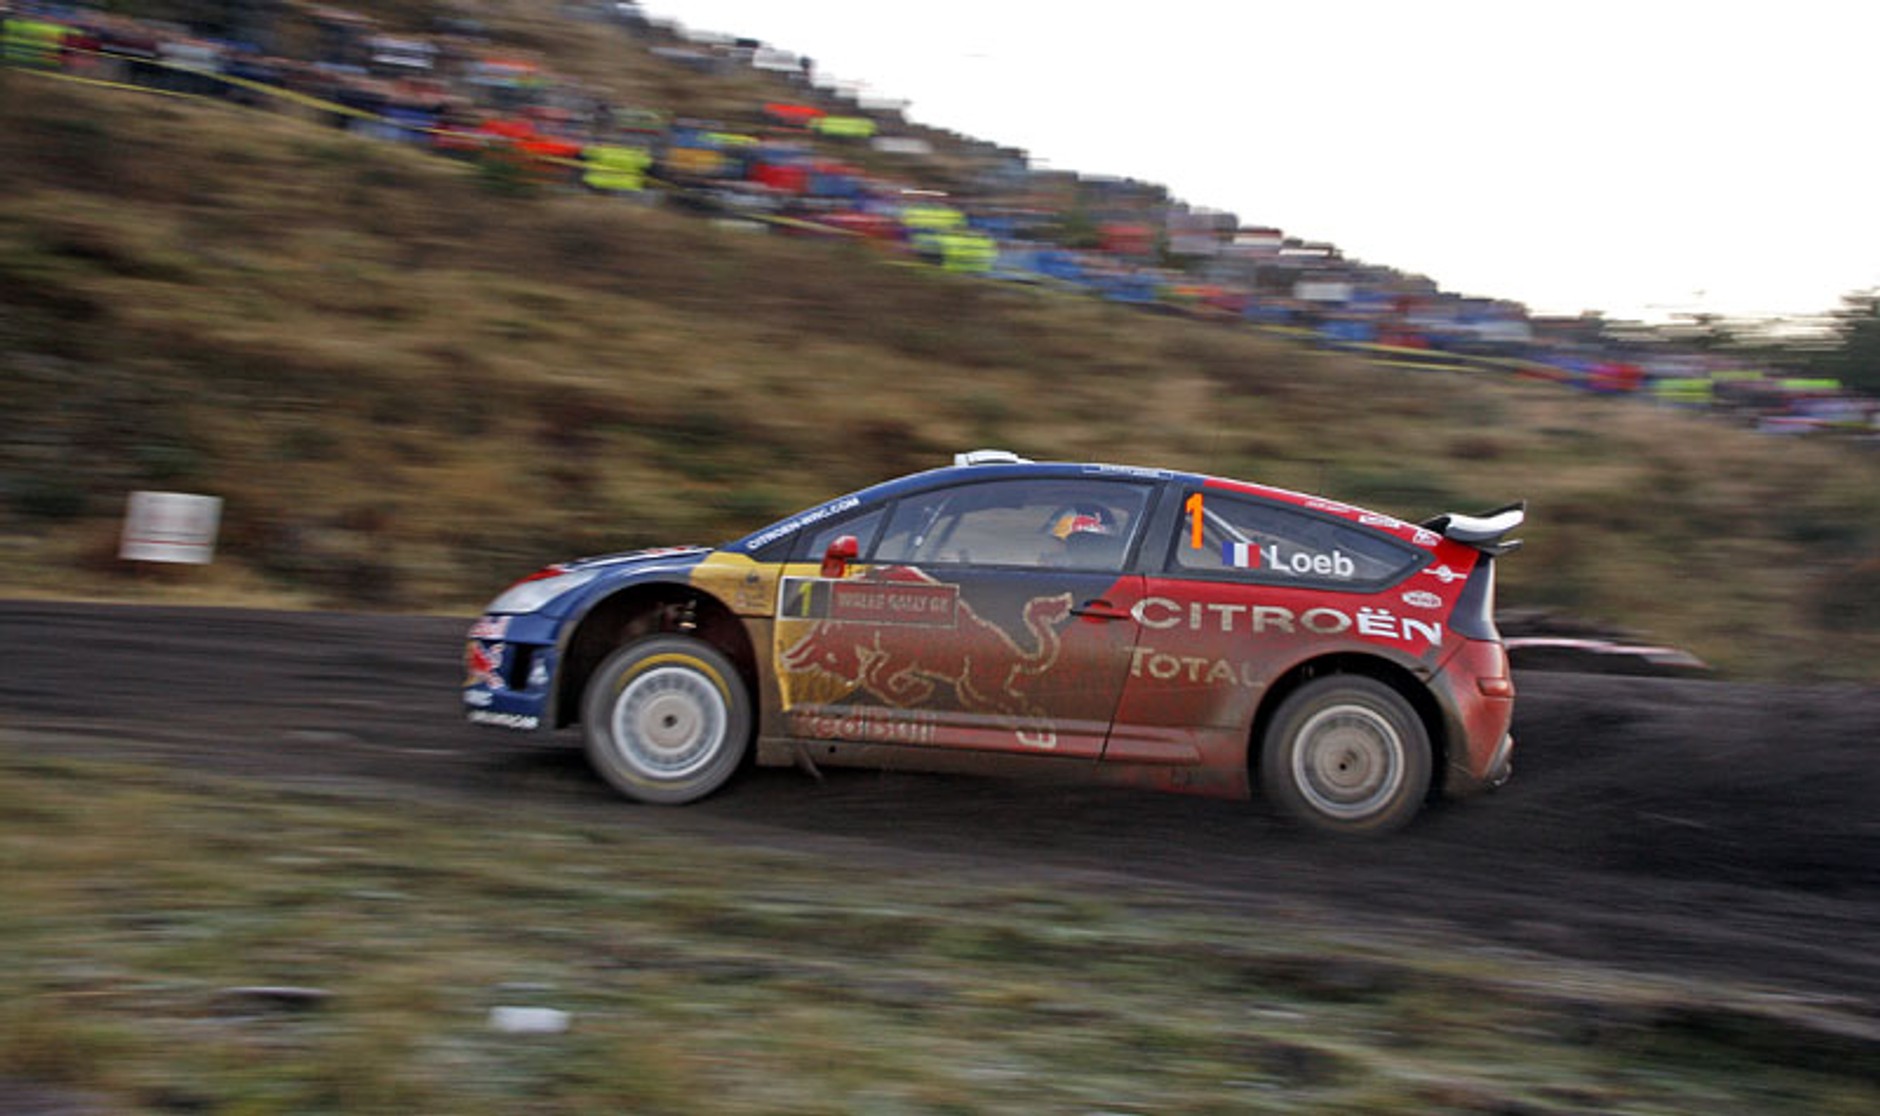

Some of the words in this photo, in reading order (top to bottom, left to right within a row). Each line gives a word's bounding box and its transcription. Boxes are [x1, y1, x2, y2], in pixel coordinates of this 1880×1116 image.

[1185, 492, 1204, 549] 1
[1269, 544, 1354, 578] Loeb
[798, 581, 812, 618] 1
[1130, 596, 1442, 646] CITROËN
